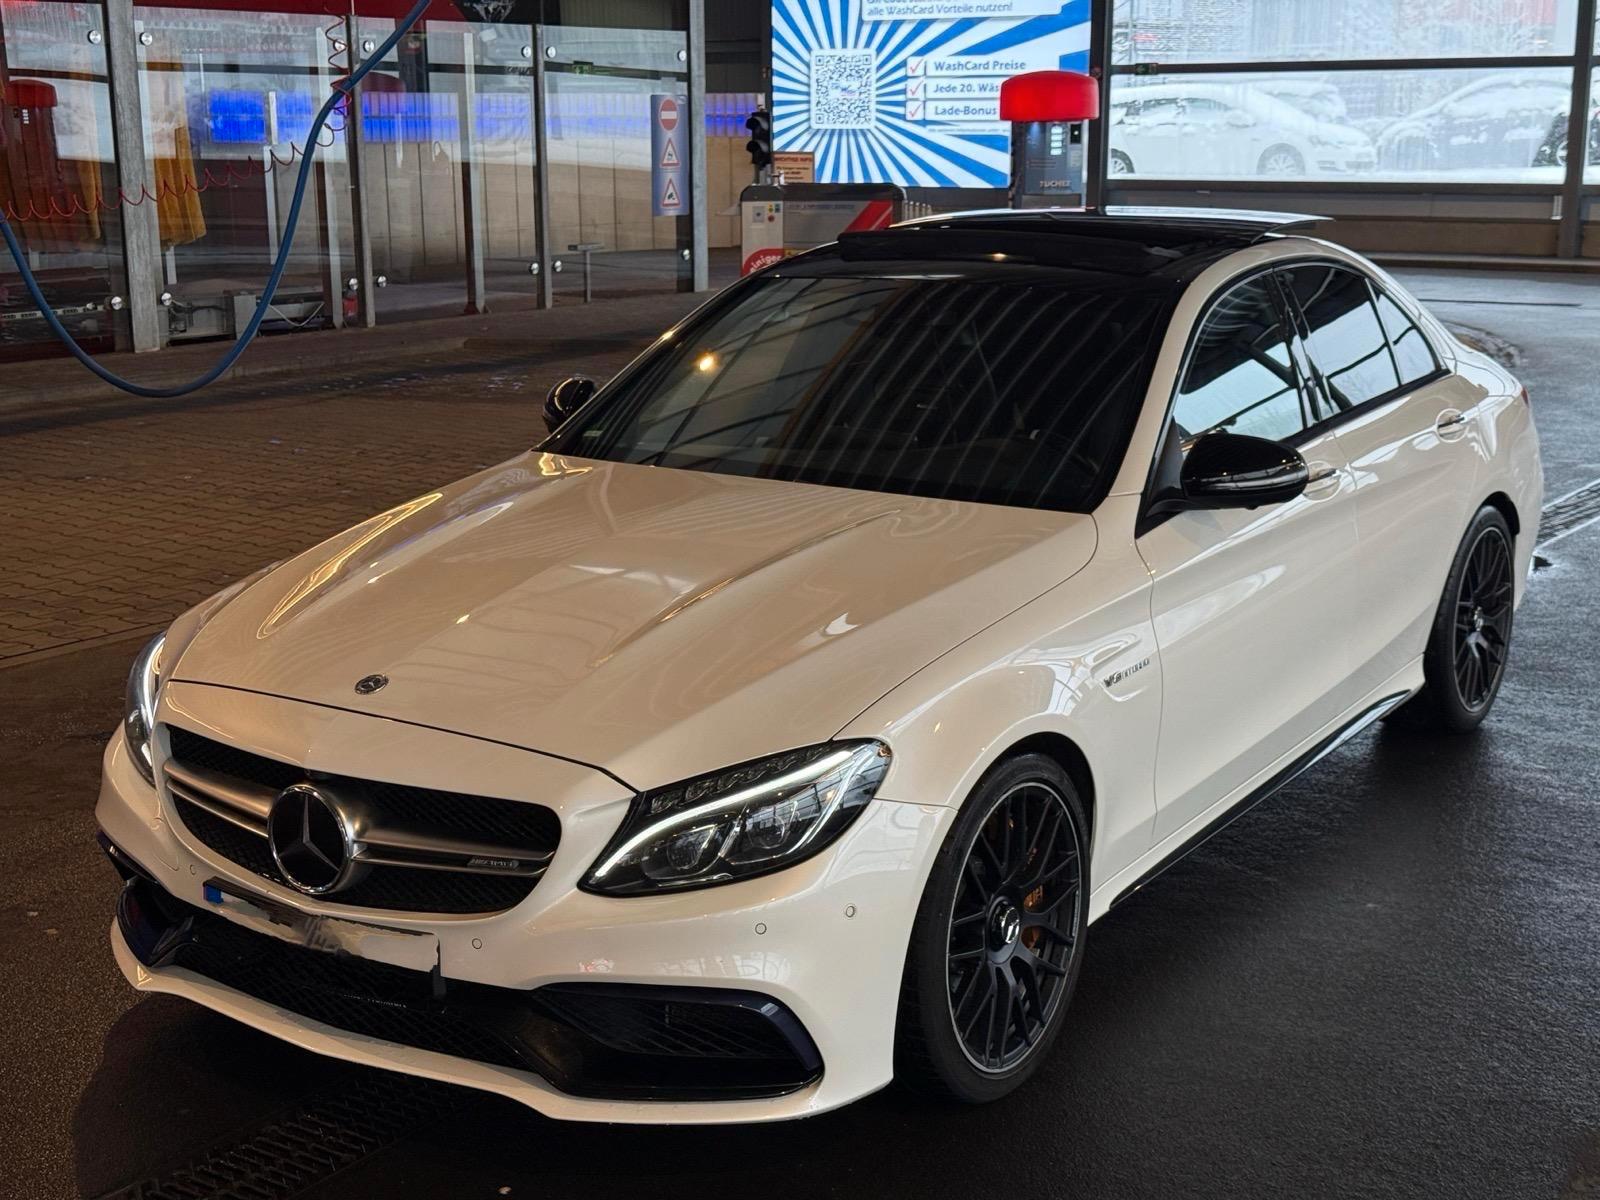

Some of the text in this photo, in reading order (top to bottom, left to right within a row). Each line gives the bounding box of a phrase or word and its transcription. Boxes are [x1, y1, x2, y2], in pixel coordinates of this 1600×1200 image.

[867, 2, 1013, 16] alle WashCard Vorteile nutzen!
[934, 60, 1026, 71] WashCard Preise
[933, 83, 999, 93] Jede 20. Wäs
[934, 105, 997, 115] Lade-Bonus
